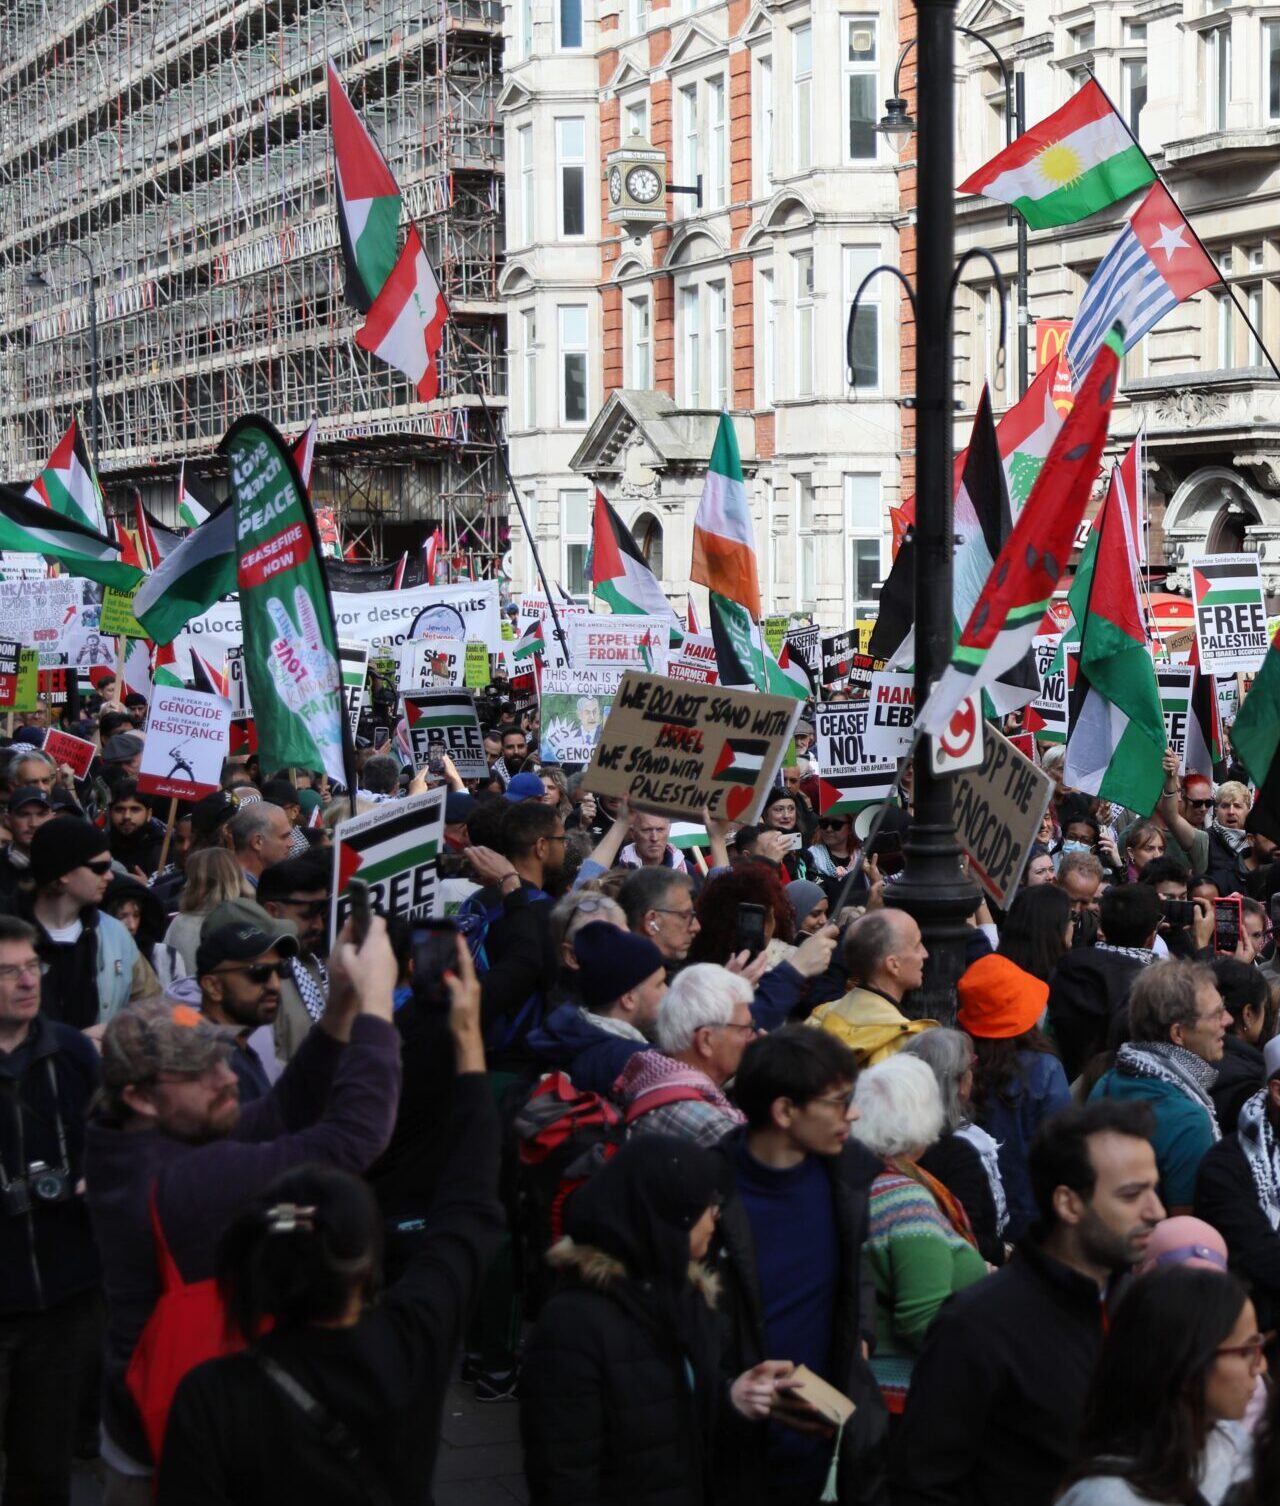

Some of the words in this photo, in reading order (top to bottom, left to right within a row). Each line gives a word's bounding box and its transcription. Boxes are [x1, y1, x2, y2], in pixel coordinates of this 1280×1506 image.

[233, 441, 269, 487] Love
[238, 455, 282, 501] March
[238, 481, 297, 541] PEACE
[240, 525, 303, 569] CEASEFIRE
[262, 551, 295, 578] NOW
[1215, 556, 1236, 564] Solidarity
[1237, 556, 1257, 564] Campaign
[426, 624, 451, 633] Jewish
[1198, 604, 1266, 635] FREE
[588, 633, 633, 647] EXPEL
[634, 634, 662, 647] UA
[788, 632, 819, 649] EASEFIRE
[834, 637, 851, 651] Free
[1201, 632, 1268, 650] PALESTINE
[274, 638, 309, 684] LOVE
[589, 648, 629, 660] FROM
[684, 643, 717, 661] HAND
[824, 648, 859, 668] Palestine
[854, 655, 873, 667] STOP
[1203, 650, 1215, 659] END
[1215, 650, 1237, 658] ISRAELI
[515, 662, 535, 676] Arm
[545, 669, 567, 681] THIS
[573, 670, 599, 682] MAN
[602, 671, 611, 682] IS
[671, 665, 708, 681] STARMER
[850, 668, 872, 683] GENO
[578, 682, 617, 695] CONFUS
[877, 685, 915, 705] HAN
[1042, 677, 1065, 703] NO
[159, 700, 223, 721] GENOCIDE
[620, 681, 651, 710] WE
[648, 686, 669, 714] DO
[674, 692, 710, 719] NOT
[705, 697, 750, 729] STAND
[751, 709, 791, 736] WITH
[874, 704, 914, 728] LEB
[151, 719, 224, 742] RESISTANCE
[820, 712, 868, 738] CEASE
[410, 726, 483, 753] FREE
[548, 727, 571, 748] IT'S
[414, 749, 484, 764] PASTINE
[598, 743, 628, 771] WE
[624, 745, 672, 775] STAND
[669, 758, 705, 781] WITH
[833, 766, 857, 774] PALESTINE
[861, 764, 870, 772] END
[871, 763, 896, 772] APARTHEID
[629, 775, 725, 812] PALESTINE
[1004, 755, 1038, 815] THE
[340, 820, 372, 836] Palestine
[373, 805, 405, 823] Solidarity
[406, 794, 443, 810] Campaign
[952, 779, 1022, 890] ENOCIDE
